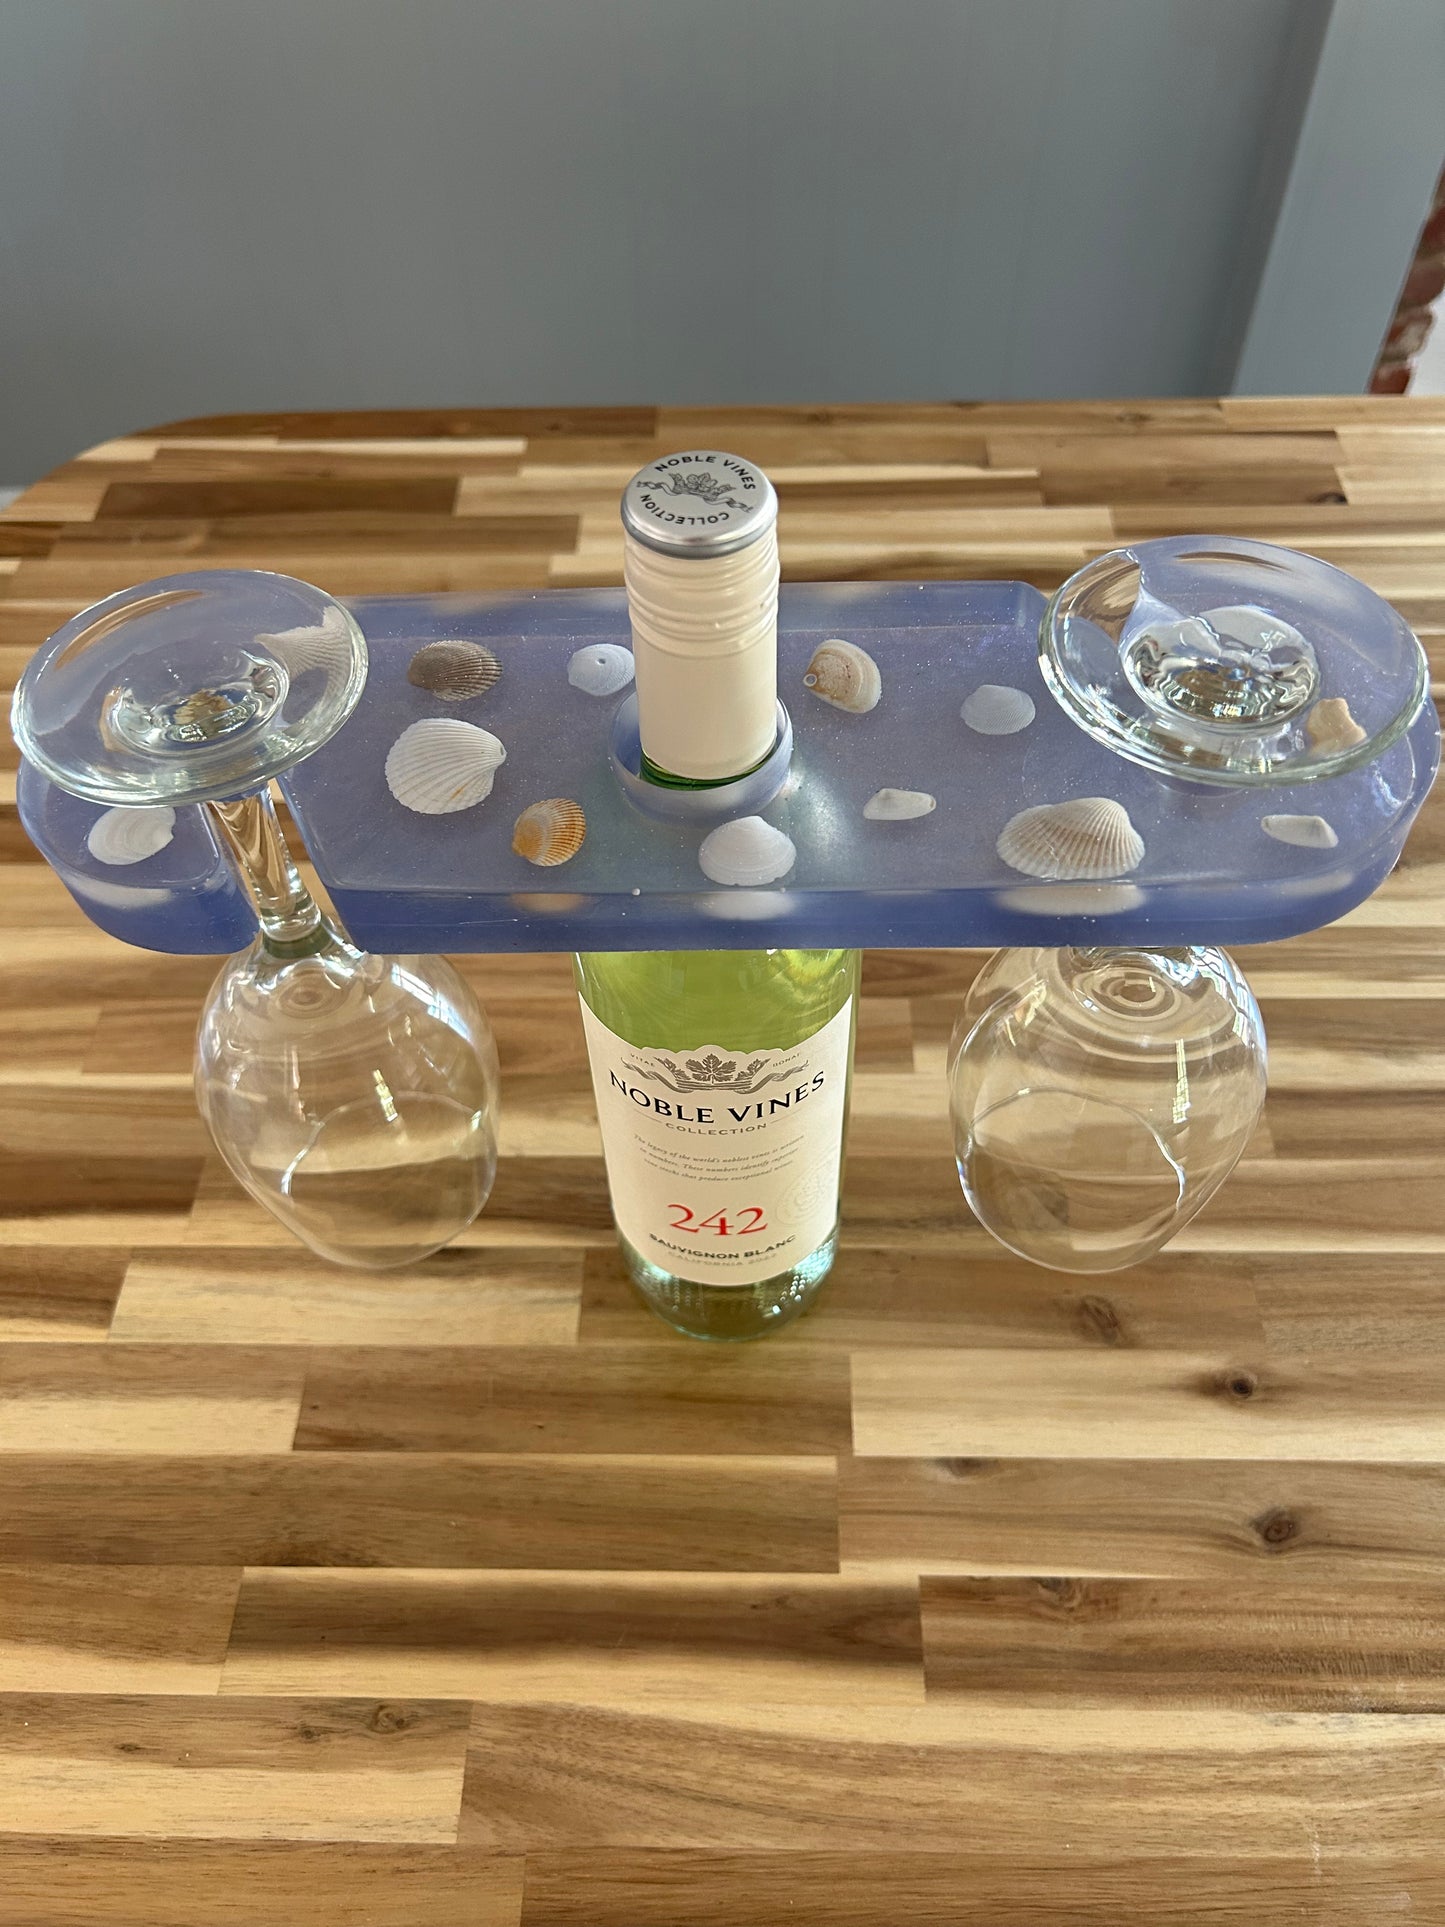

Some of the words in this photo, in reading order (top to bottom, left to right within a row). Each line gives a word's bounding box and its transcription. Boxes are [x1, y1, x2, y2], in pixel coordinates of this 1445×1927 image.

[654, 455, 717, 473] NOBLE
[723, 459, 756, 490] VINES
[640, 494, 730, 525] COLLECTION
[609, 1068, 714, 1123] NOBLE
[727, 1070, 825, 1123] VINES
[665, 1122, 767, 1136] COLLECTION
[667, 1203, 768, 1236] 242
[649, 1233, 740, 1259] SAUVIGNON
[743, 1234, 796, 1258] BLANC
